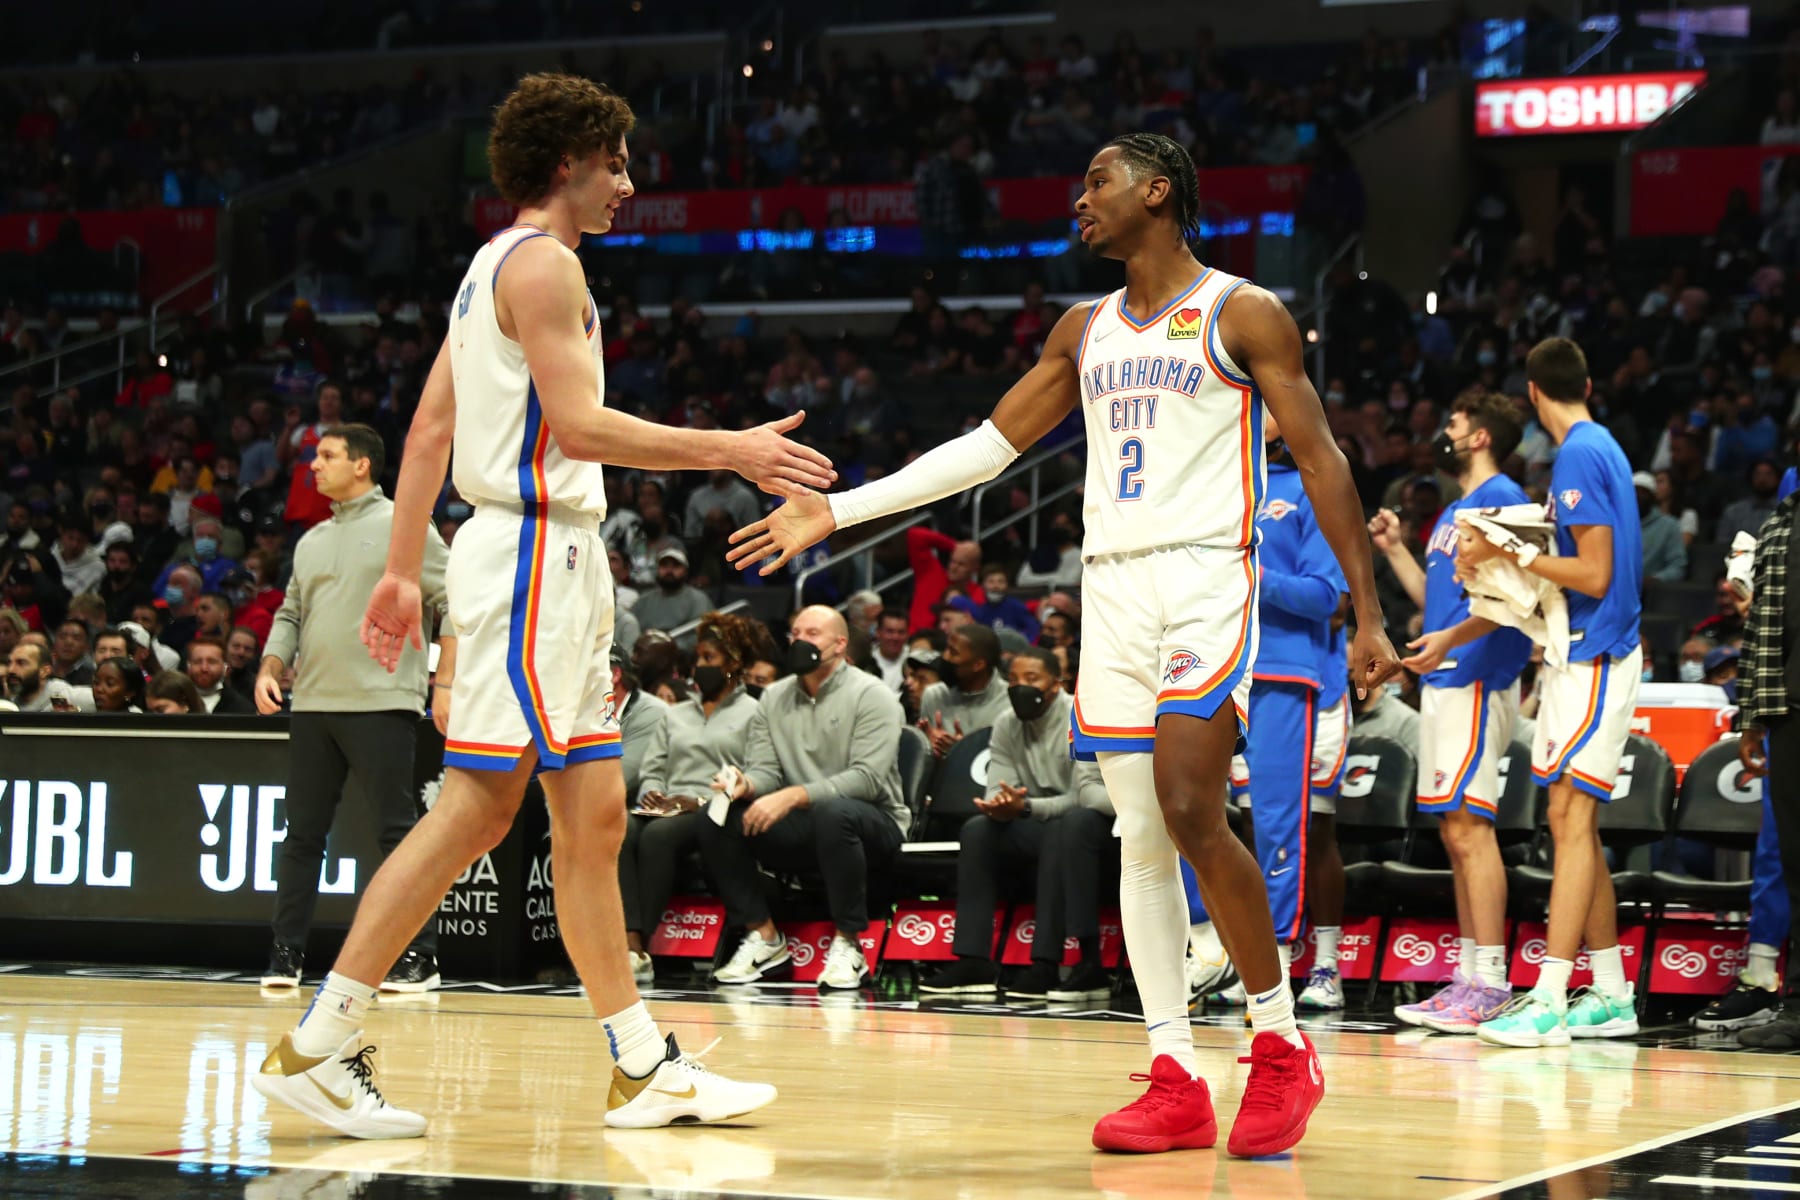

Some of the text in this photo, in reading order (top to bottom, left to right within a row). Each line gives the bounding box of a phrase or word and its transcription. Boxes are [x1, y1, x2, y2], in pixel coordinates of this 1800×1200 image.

[1083, 356, 1205, 405] OKLAHOMA
[1110, 395, 1159, 432] CITY
[1115, 436, 1146, 503] 2
[661, 910, 718, 925] Cedars
[664, 924, 706, 940] Sinai
